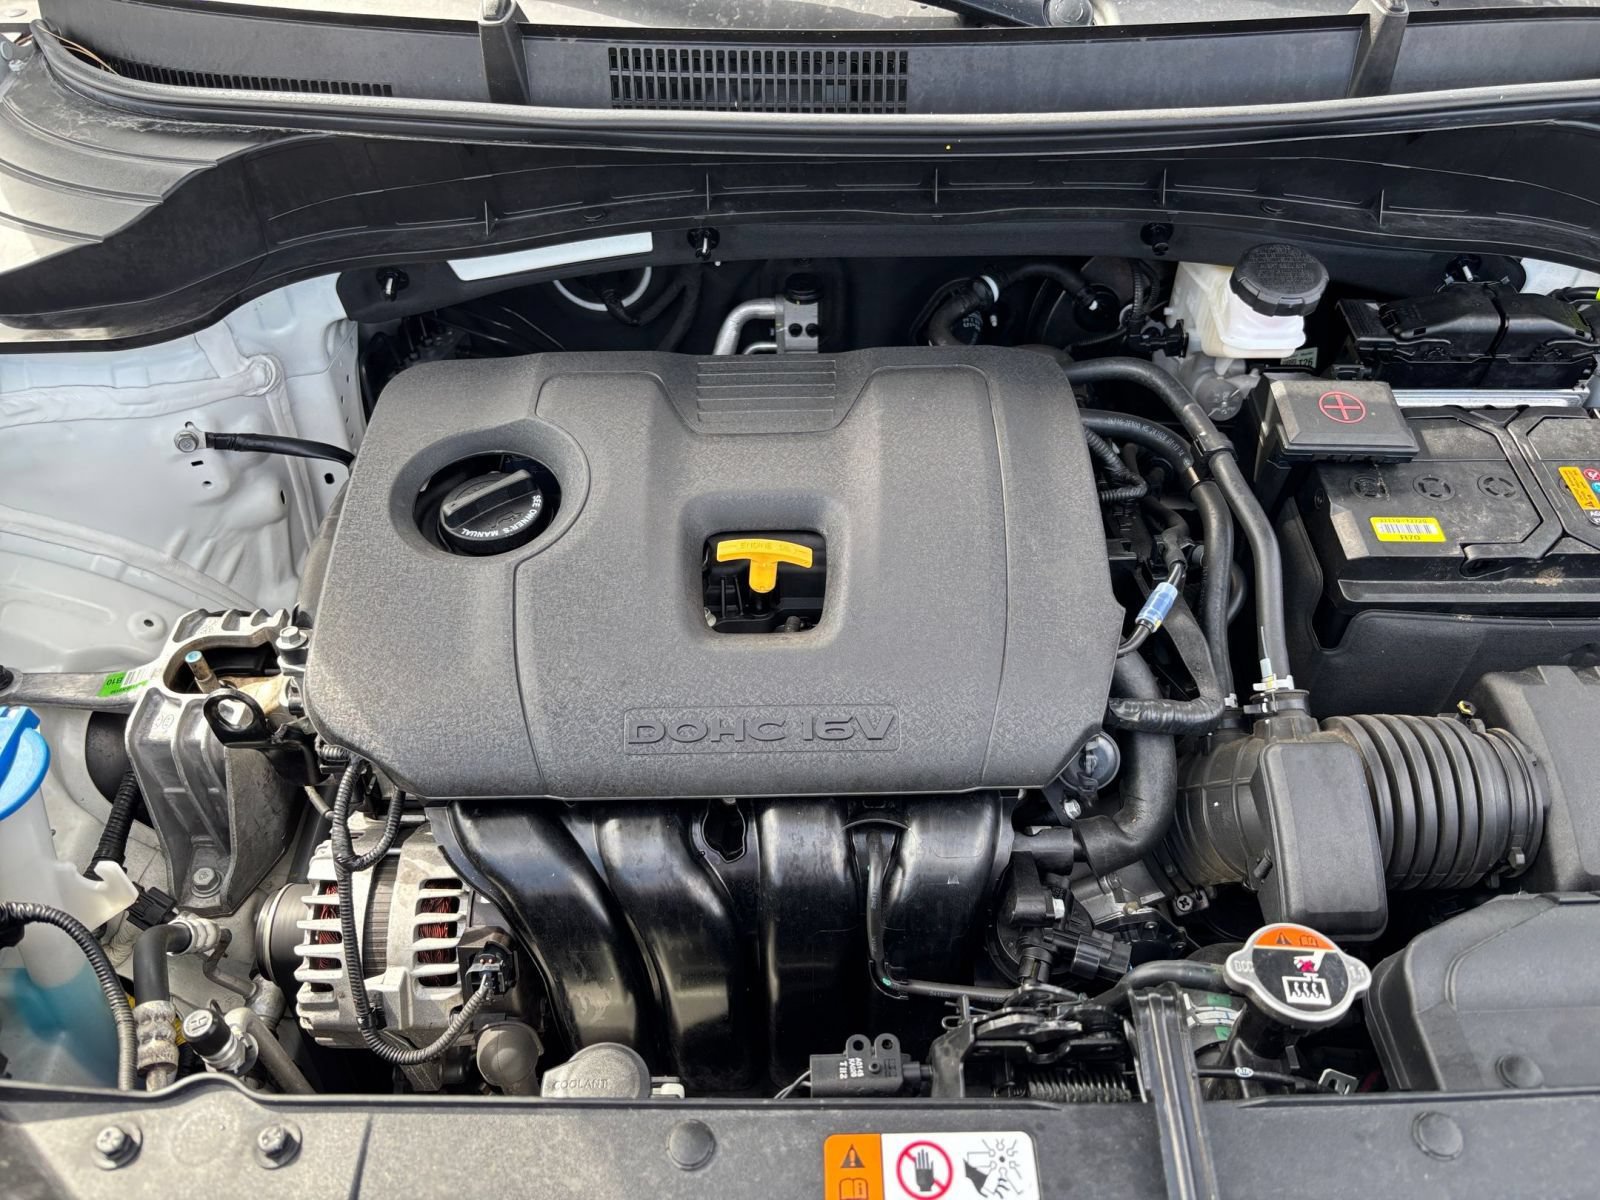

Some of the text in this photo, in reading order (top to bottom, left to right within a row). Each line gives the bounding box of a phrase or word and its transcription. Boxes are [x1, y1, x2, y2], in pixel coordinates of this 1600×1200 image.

[461, 494, 542, 538] SEE OWNER'S MANUAL
[627, 712, 895, 745] DOHC 16V
[552, 1078, 610, 1091] COOLANT
